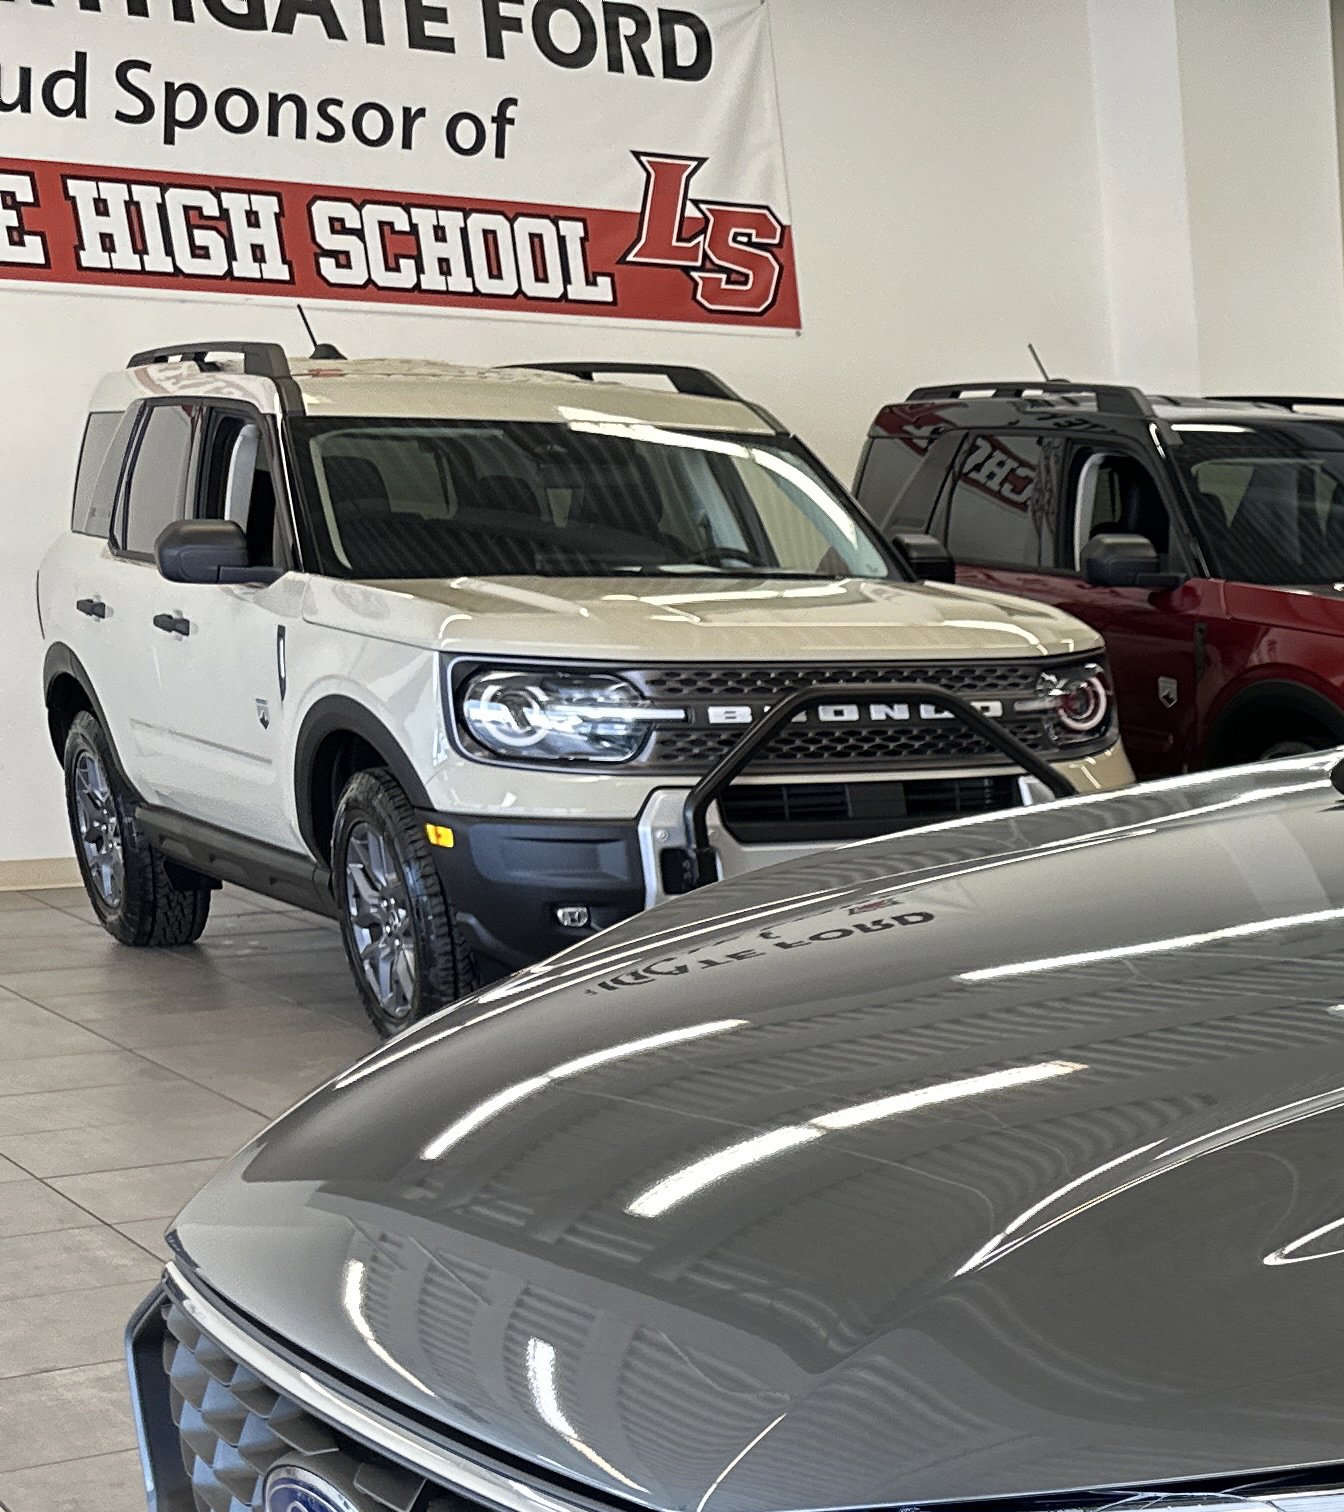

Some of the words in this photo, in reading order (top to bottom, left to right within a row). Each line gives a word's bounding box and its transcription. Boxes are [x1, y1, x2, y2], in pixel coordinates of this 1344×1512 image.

[481, 0, 713, 82] FORD
[113, 58, 426, 150] Sponsor
[445, 97, 519, 159] of
[60, 174, 296, 285] HIGH
[307, 195, 618, 305] SCHOOL
[615, 150, 785, 317] LS
